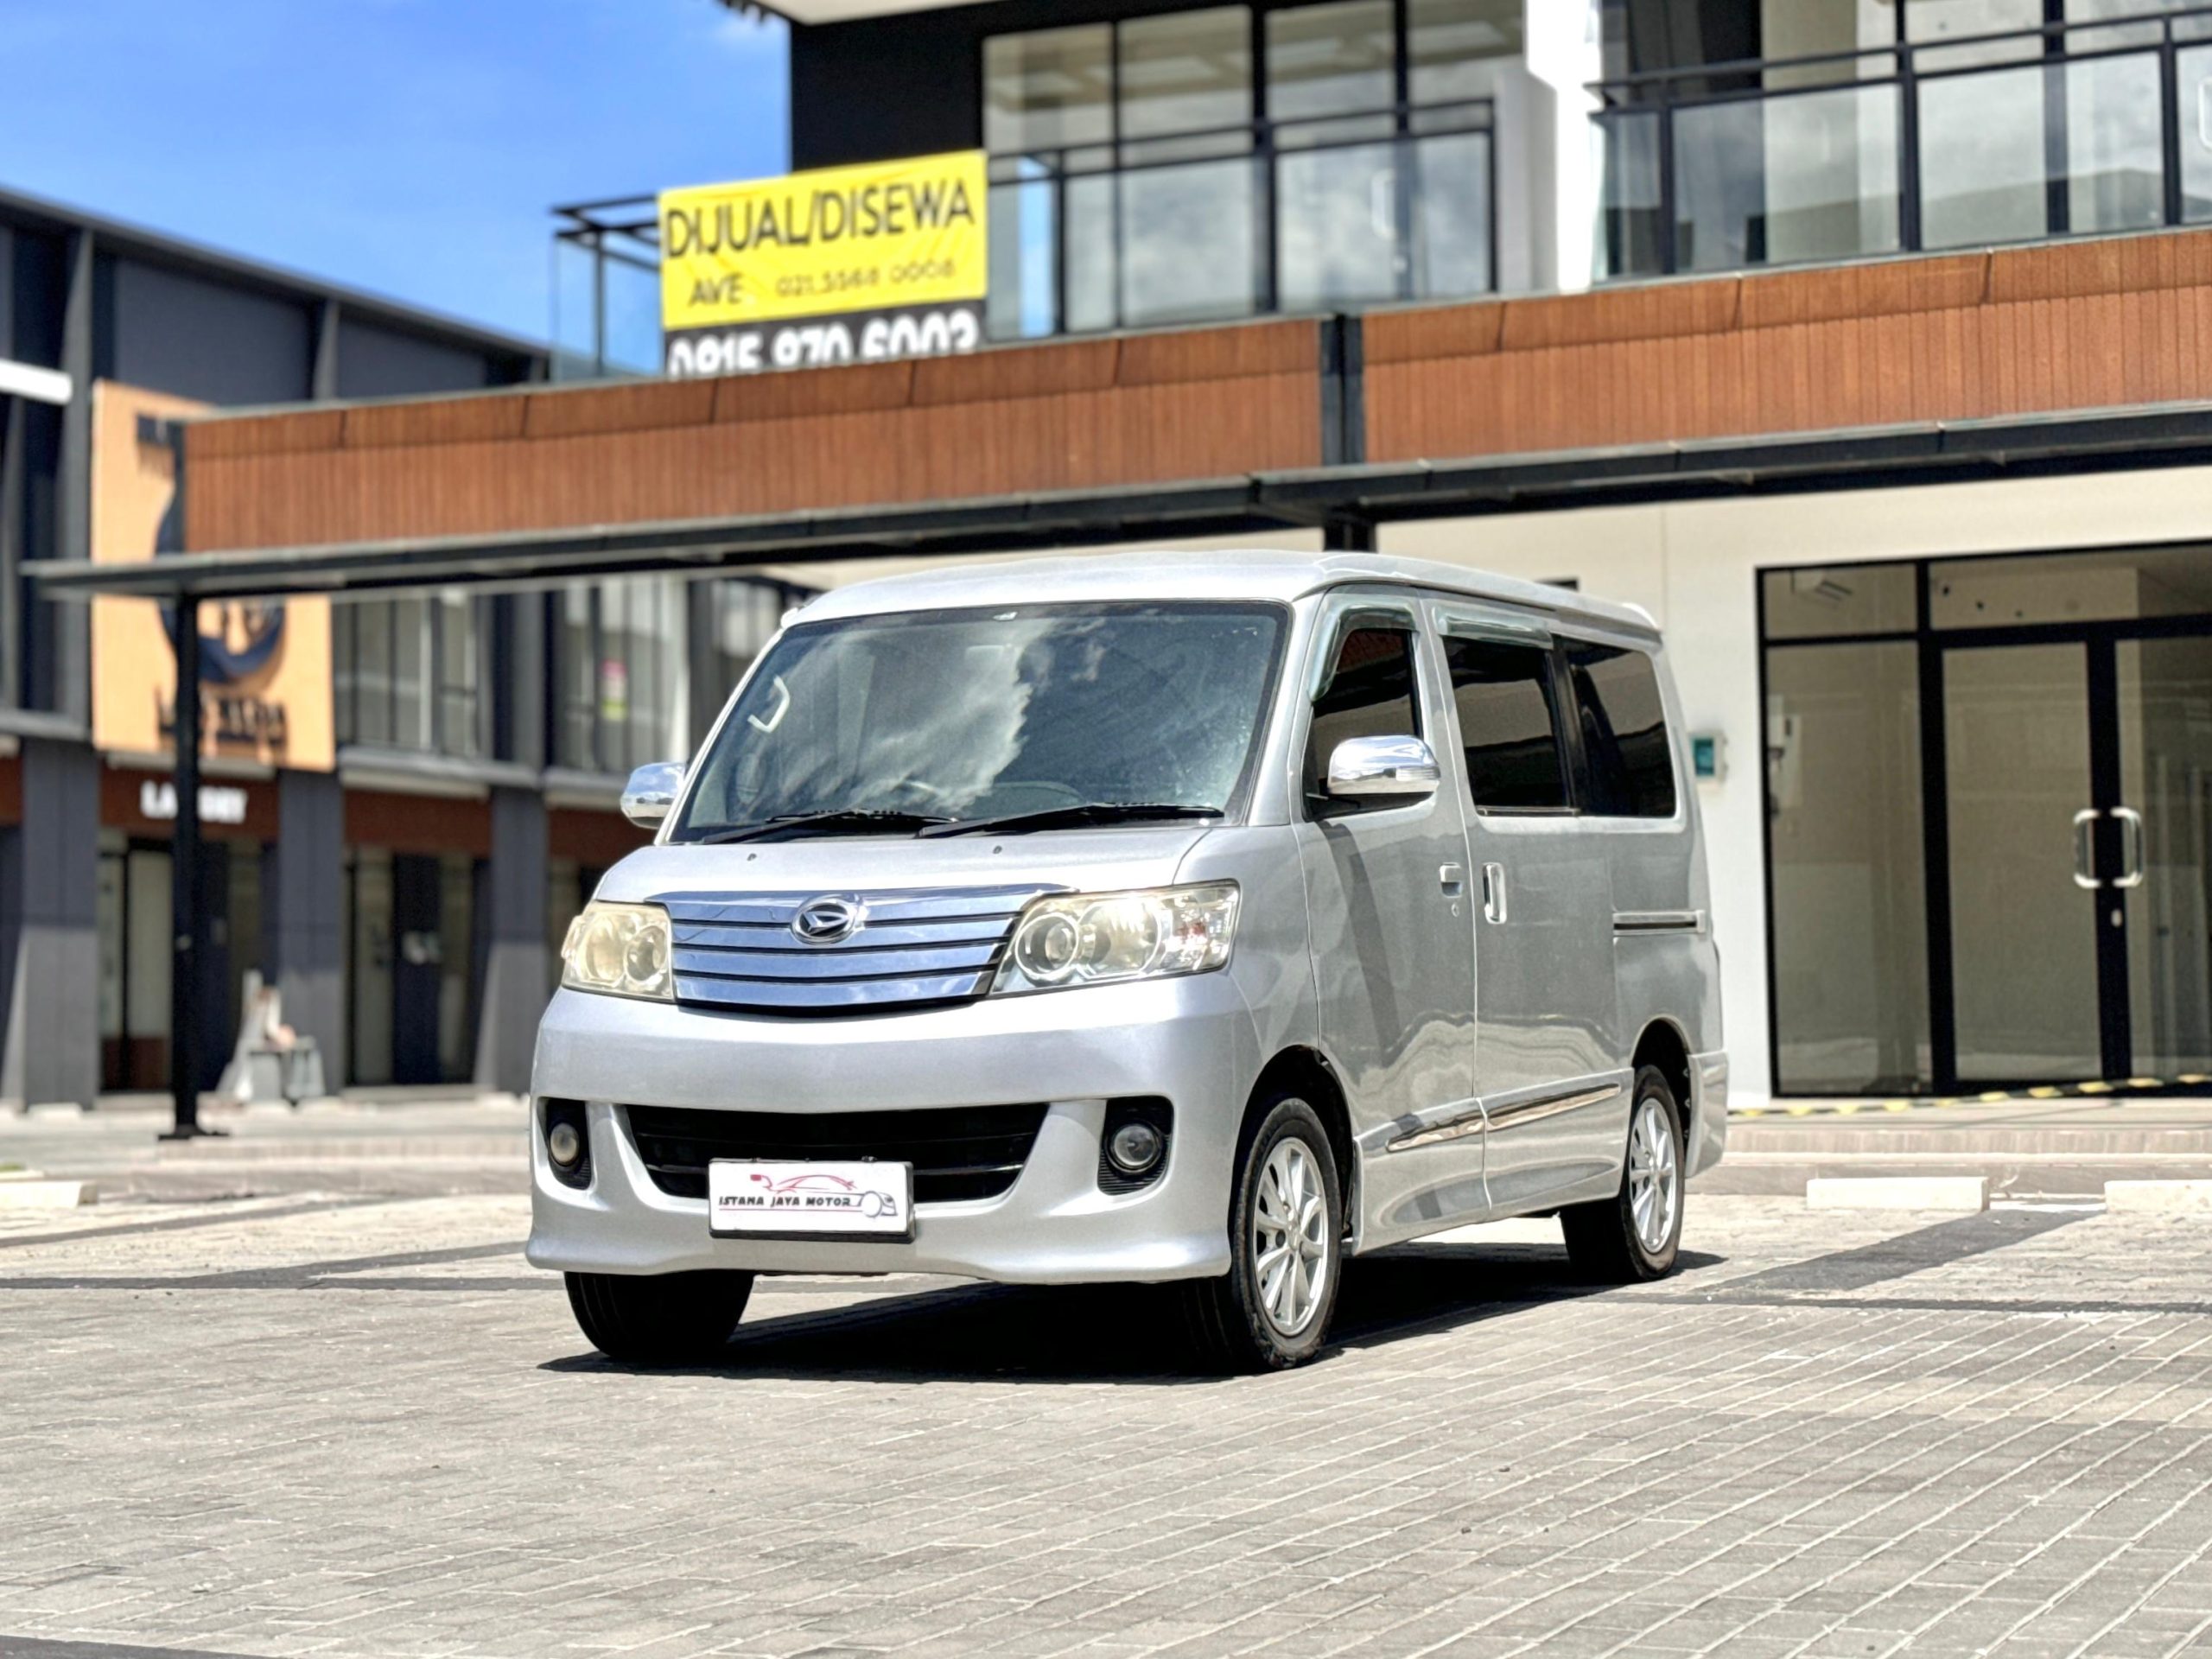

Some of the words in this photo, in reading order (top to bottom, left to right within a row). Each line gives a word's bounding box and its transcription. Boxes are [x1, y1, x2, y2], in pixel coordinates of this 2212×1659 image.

[666, 178, 976, 258] DIJUAL/DISEWA
[688, 270, 745, 308] AVE
[718, 1196, 765, 1206] ISTANA
[770, 1196, 800, 1208] JAYA
[805, 1197, 851, 1207] MOTOR
